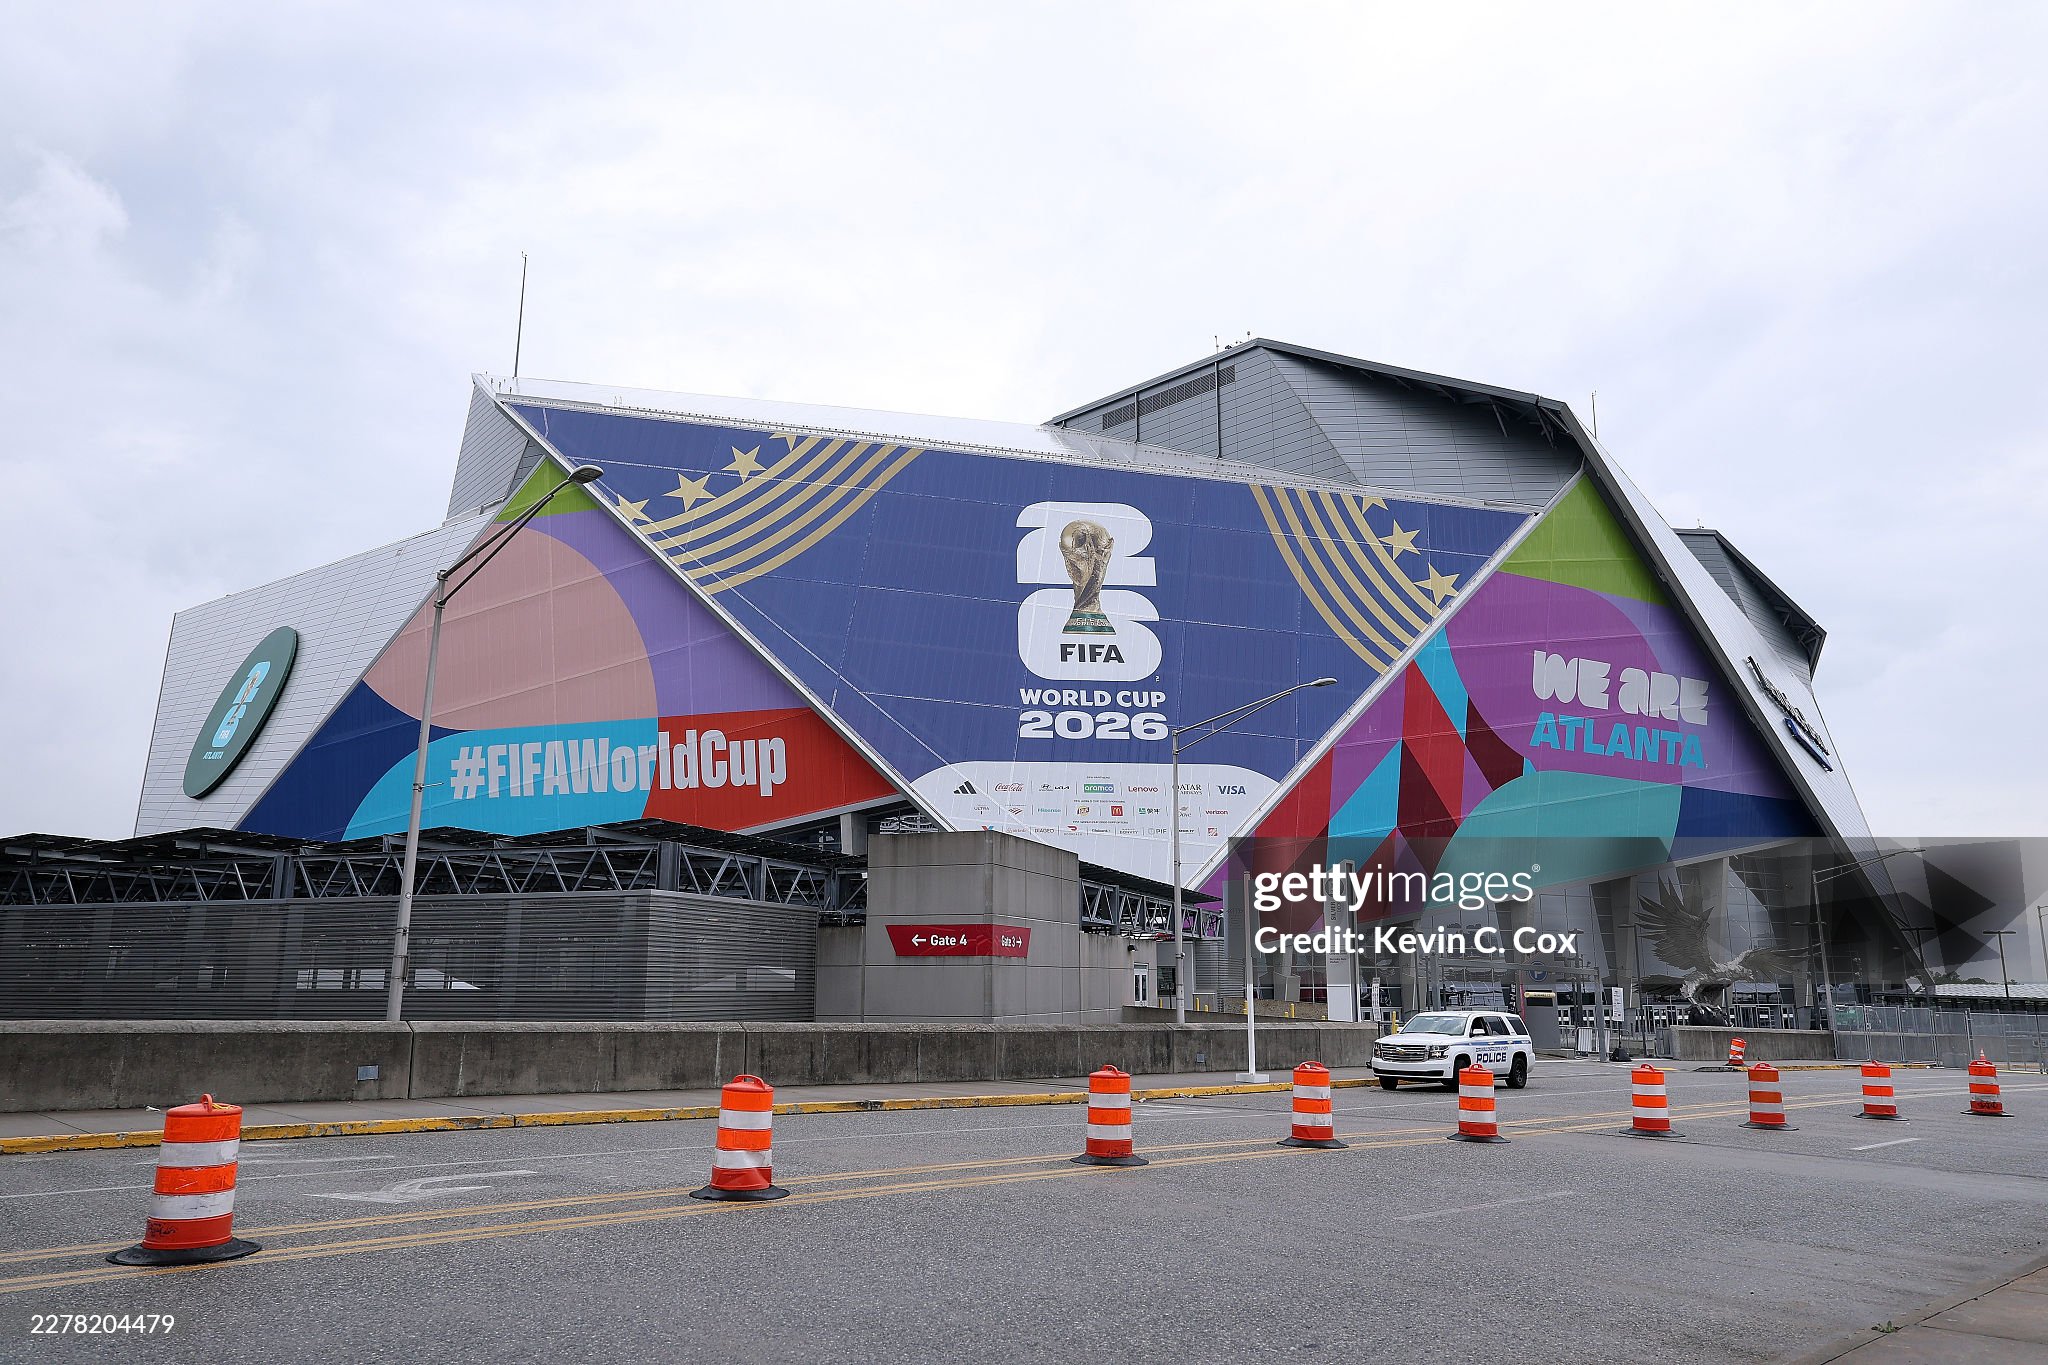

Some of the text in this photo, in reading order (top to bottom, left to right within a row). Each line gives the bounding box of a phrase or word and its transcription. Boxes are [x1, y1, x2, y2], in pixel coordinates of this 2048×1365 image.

[1060, 643, 1125, 663] FIFA
[1532, 650, 1611, 710] WE
[1019, 688, 1166, 708] WORLD CUP
[1019, 710, 1169, 741] 2026
[1529, 712, 1705, 769] ATLANTA
[203, 751, 224, 760] ATLANTA
[450, 729, 787, 800] #FIFAWorldCup
[1217, 785, 1247, 795] VISA
[930, 934, 968, 947] Gate 4
[1001, 935, 1012, 947] Gate
[1476, 1052, 1507, 1064] POLICE
